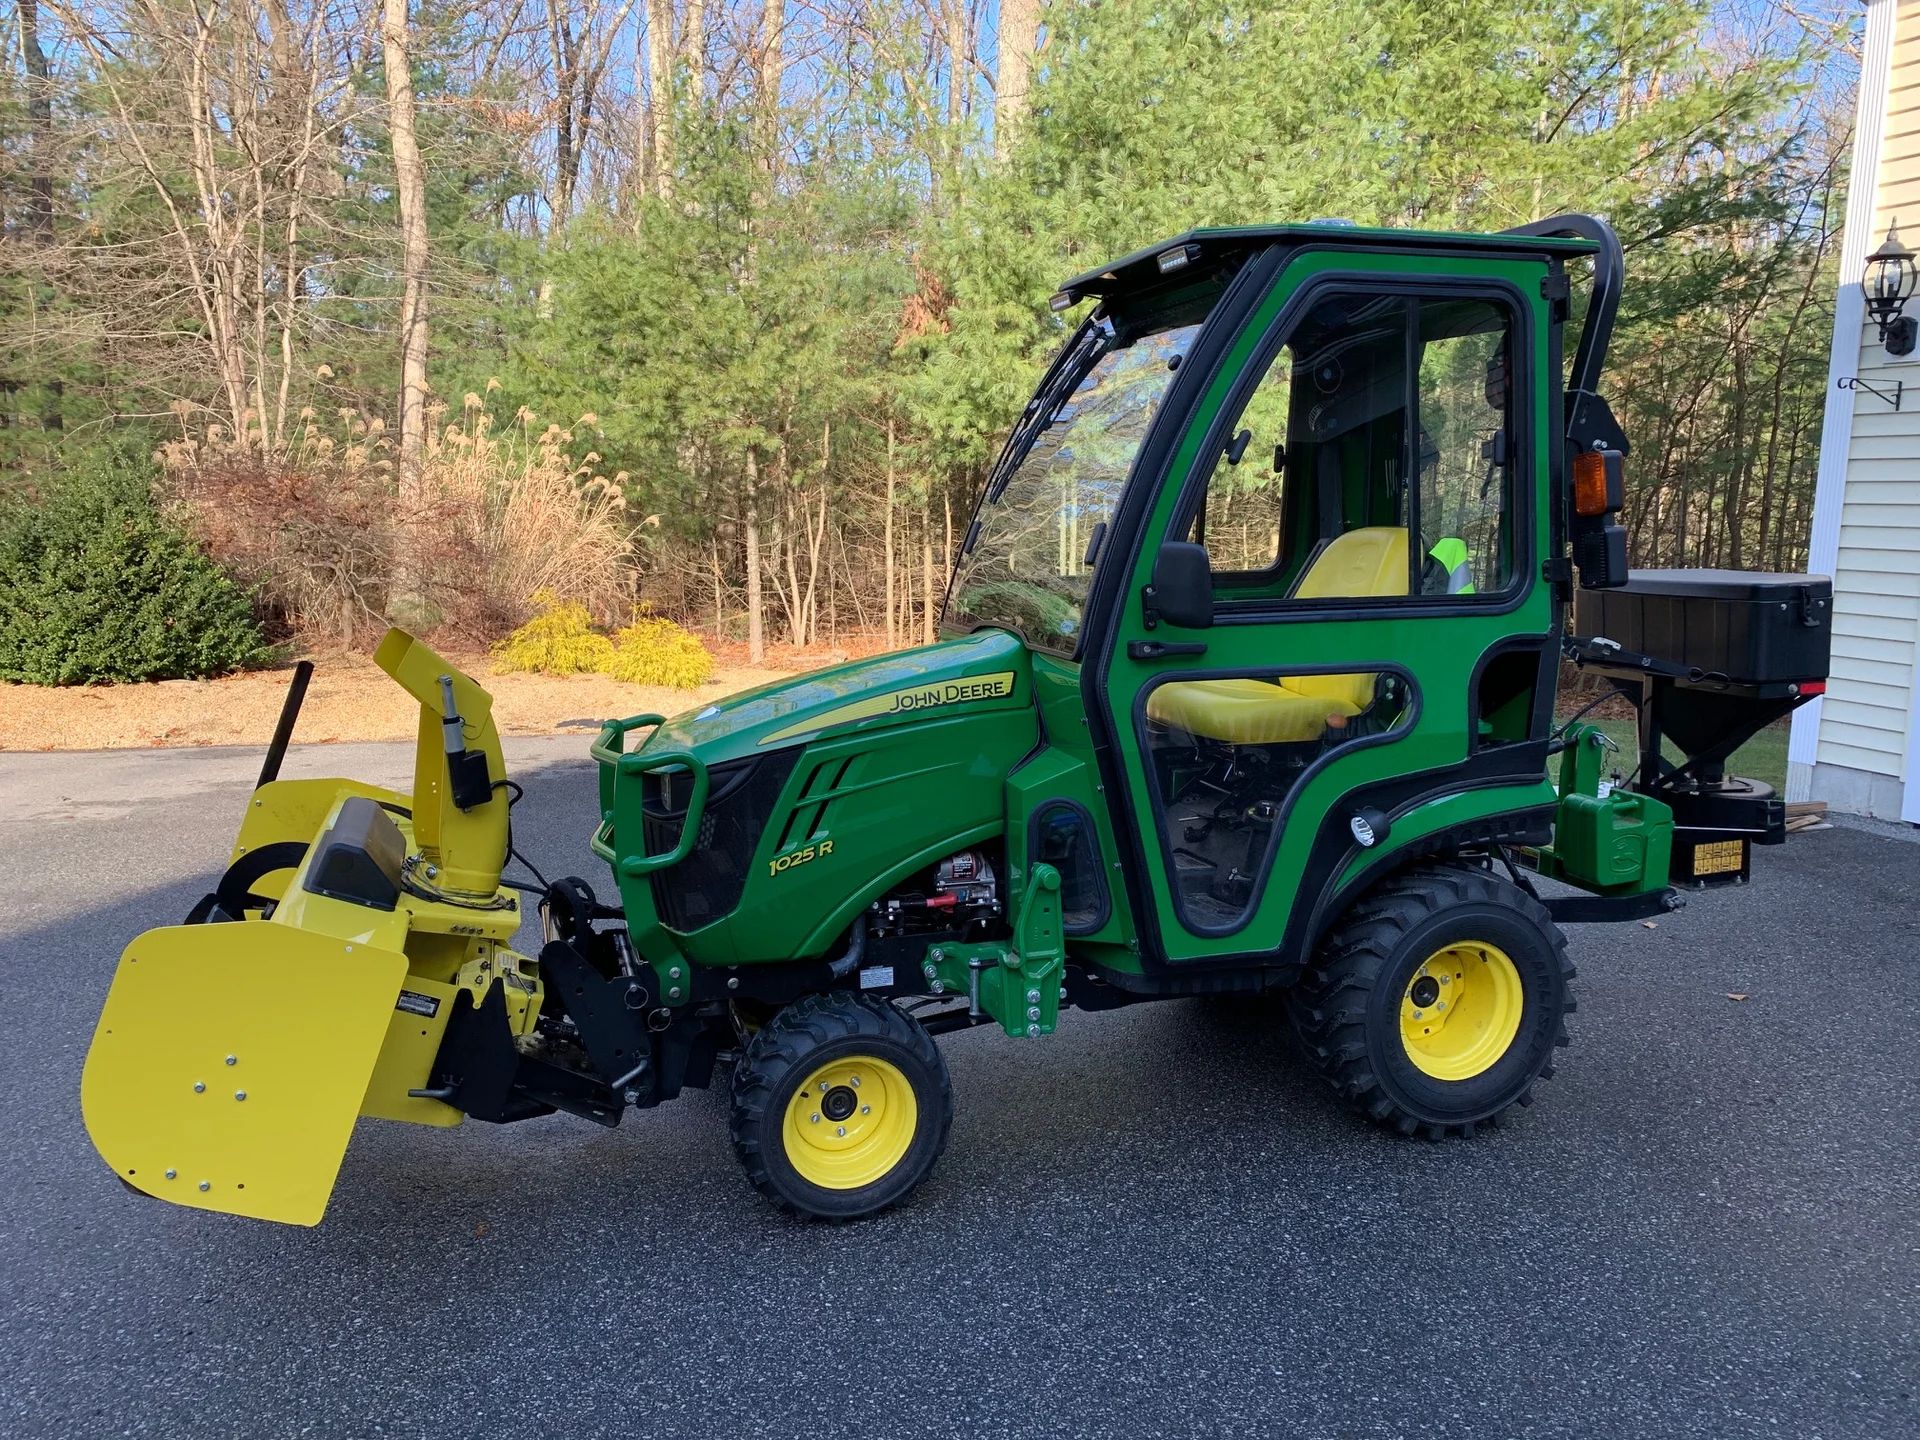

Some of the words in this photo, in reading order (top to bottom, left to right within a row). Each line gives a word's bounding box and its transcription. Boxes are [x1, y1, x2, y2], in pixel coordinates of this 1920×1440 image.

[889, 690, 941, 712] JOHN
[945, 681, 1005, 701] DEERE
[769, 846, 815, 876] 1025
[819, 840, 834, 857] R
